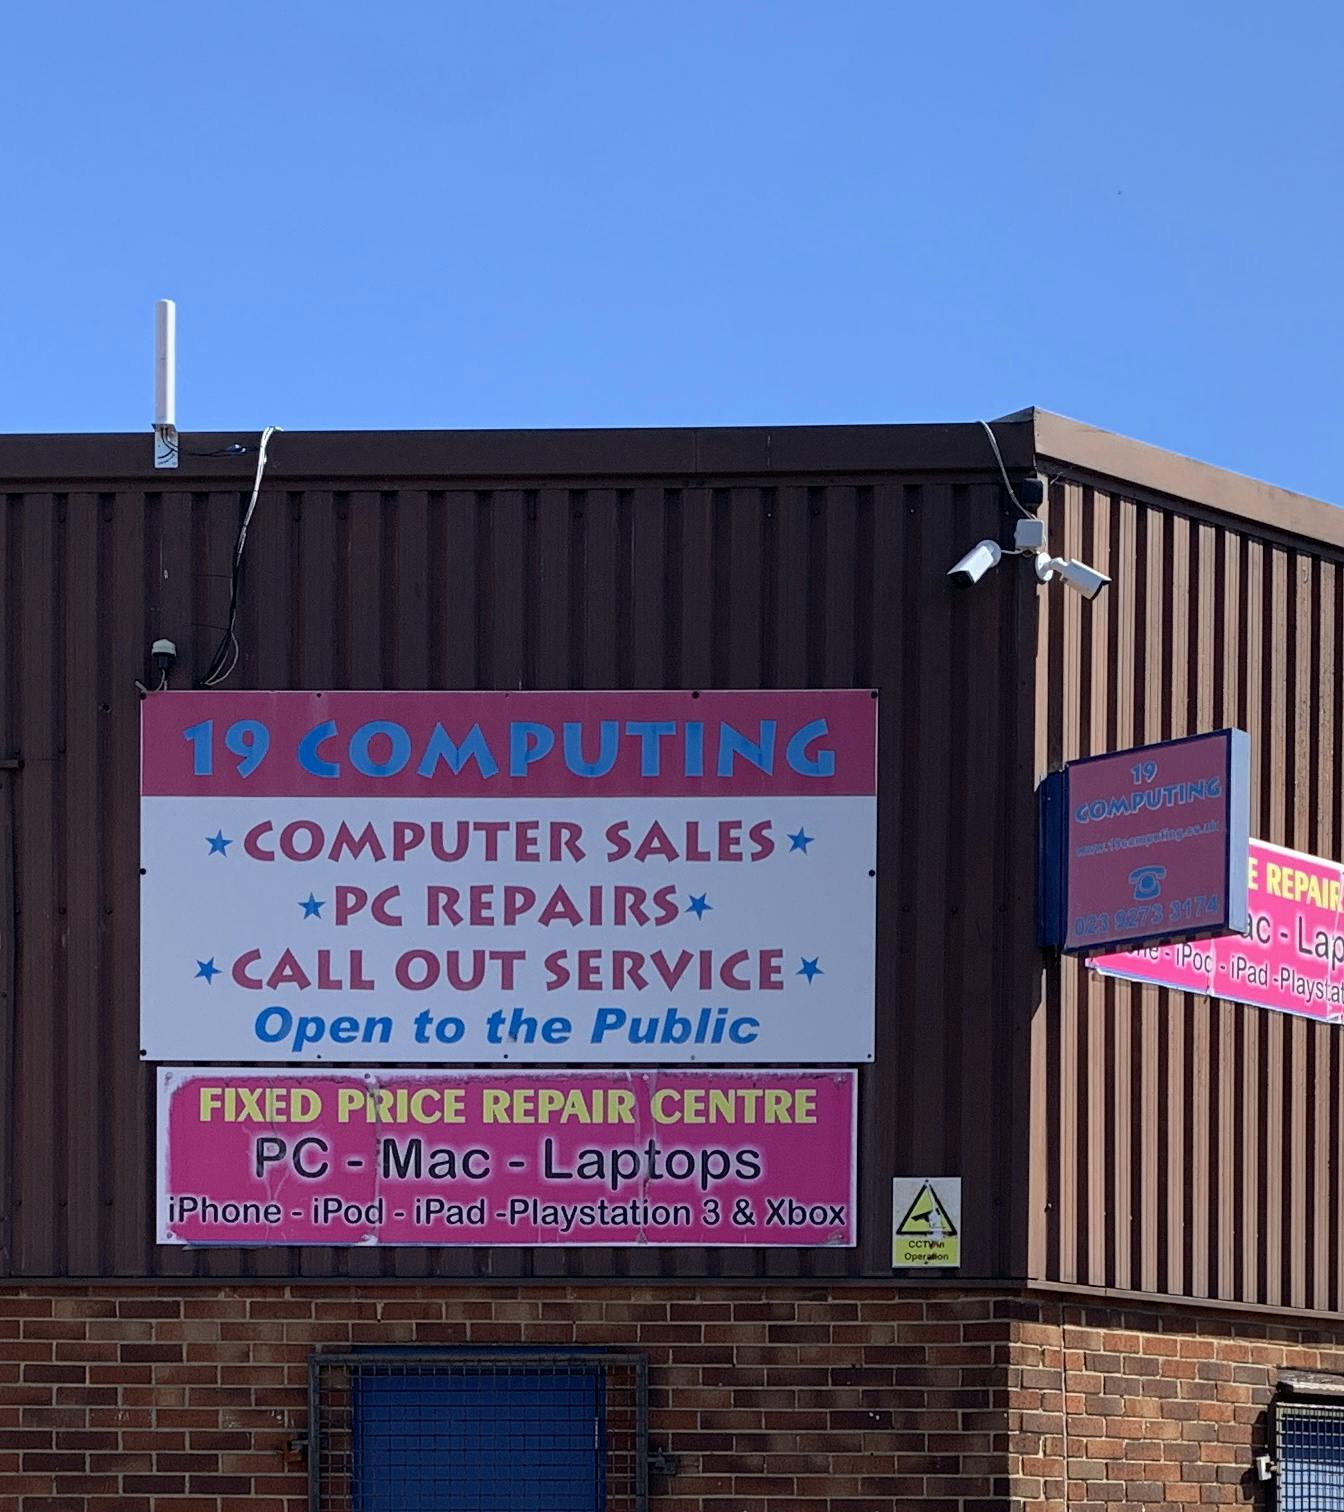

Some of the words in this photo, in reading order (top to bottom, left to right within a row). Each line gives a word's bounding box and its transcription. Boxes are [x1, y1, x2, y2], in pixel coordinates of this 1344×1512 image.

[184, 719, 270, 778] 19
[298, 717, 837, 779] COMPUTING
[1130, 760, 1158, 785] 19
[1075, 776, 1222, 824] COMPUTING
[244, 819, 586, 863] COMPUTER
[607, 819, 775, 862] SALES
[335, 885, 402, 927] PC
[427, 884, 680, 927] REPAIRS
[1266, 862, 1344, 914] REPAIR
[1074, 913, 1109, 936] 023
[1169, 895, 1218, 921] 3174
[231, 949, 375, 991] CALL
[395, 949, 526, 991] OUT
[546, 948, 785, 991] SERVICE
[1231, 955, 1268, 986] iPad
[255, 1006, 393, 1052] Open
[414, 1010, 465, 1045] to
[487, 1006, 572, 1045] the
[592, 1006, 760, 1045] Public
[199, 1088, 321, 1123] FIXED
[338, 1088, 466, 1123] PRICE
[483, 1088, 636, 1123] REPAIR
[650, 1087, 817, 1124] CENTRE
[256, 1138, 328, 1180] PC
[383, 1138, 491, 1180] Mac
[544, 1138, 762, 1192] Laptops
[169, 1197, 282, 1226] iPhone
[313, 1197, 384, 1226] iPod
[414, 1197, 485, 1226] iPad
[702, 1201, 720, 1226] 3
[732, 1201, 755, 1226] &
[765, 1199, 846, 1227] Xbox
[904, 1252, 949, 1262] Operation
[908, 1240, 934, 1249] CCTV
